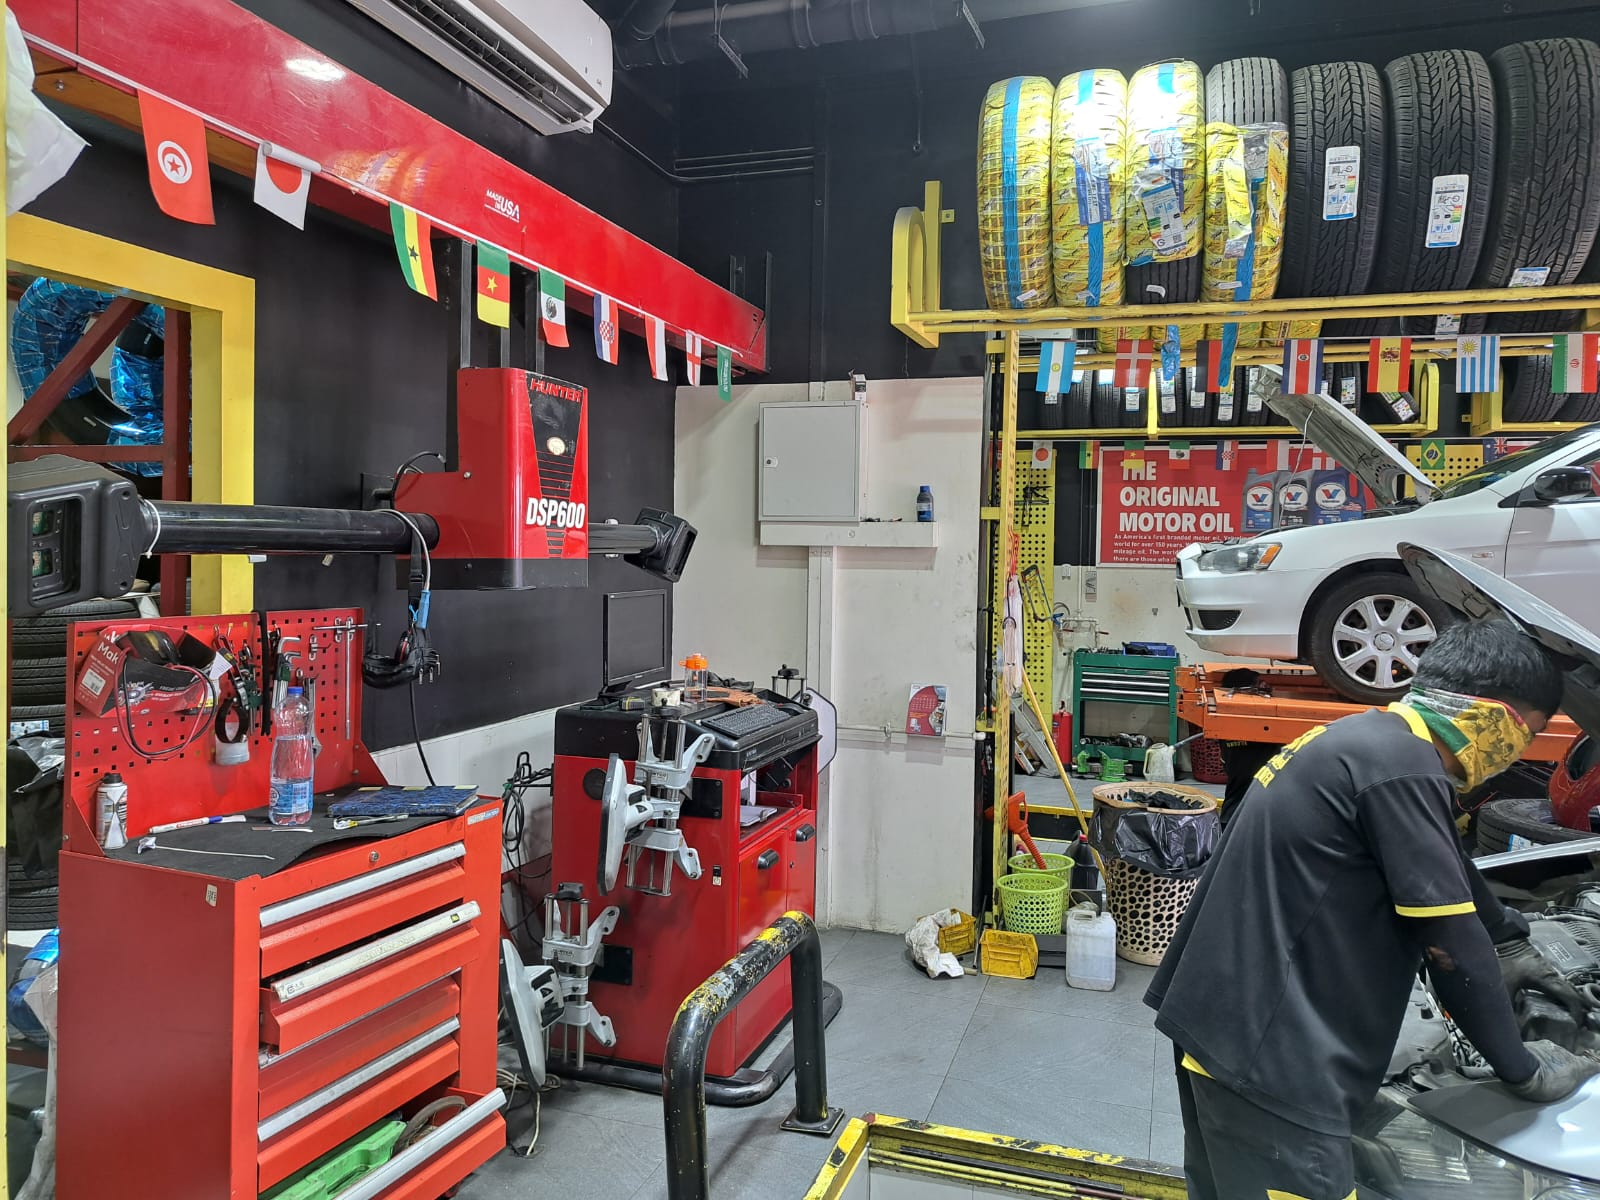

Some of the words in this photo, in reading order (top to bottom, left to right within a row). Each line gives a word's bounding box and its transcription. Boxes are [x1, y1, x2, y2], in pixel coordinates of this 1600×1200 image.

[500, 197, 520, 220] USA
[530, 377, 583, 403] HUNTER
[1119, 486, 1220, 507] ORIGINAL
[526, 497, 586, 529] DSP600
[1119, 512, 1196, 533] MOTOR
[1200, 512, 1234, 533] OIL
